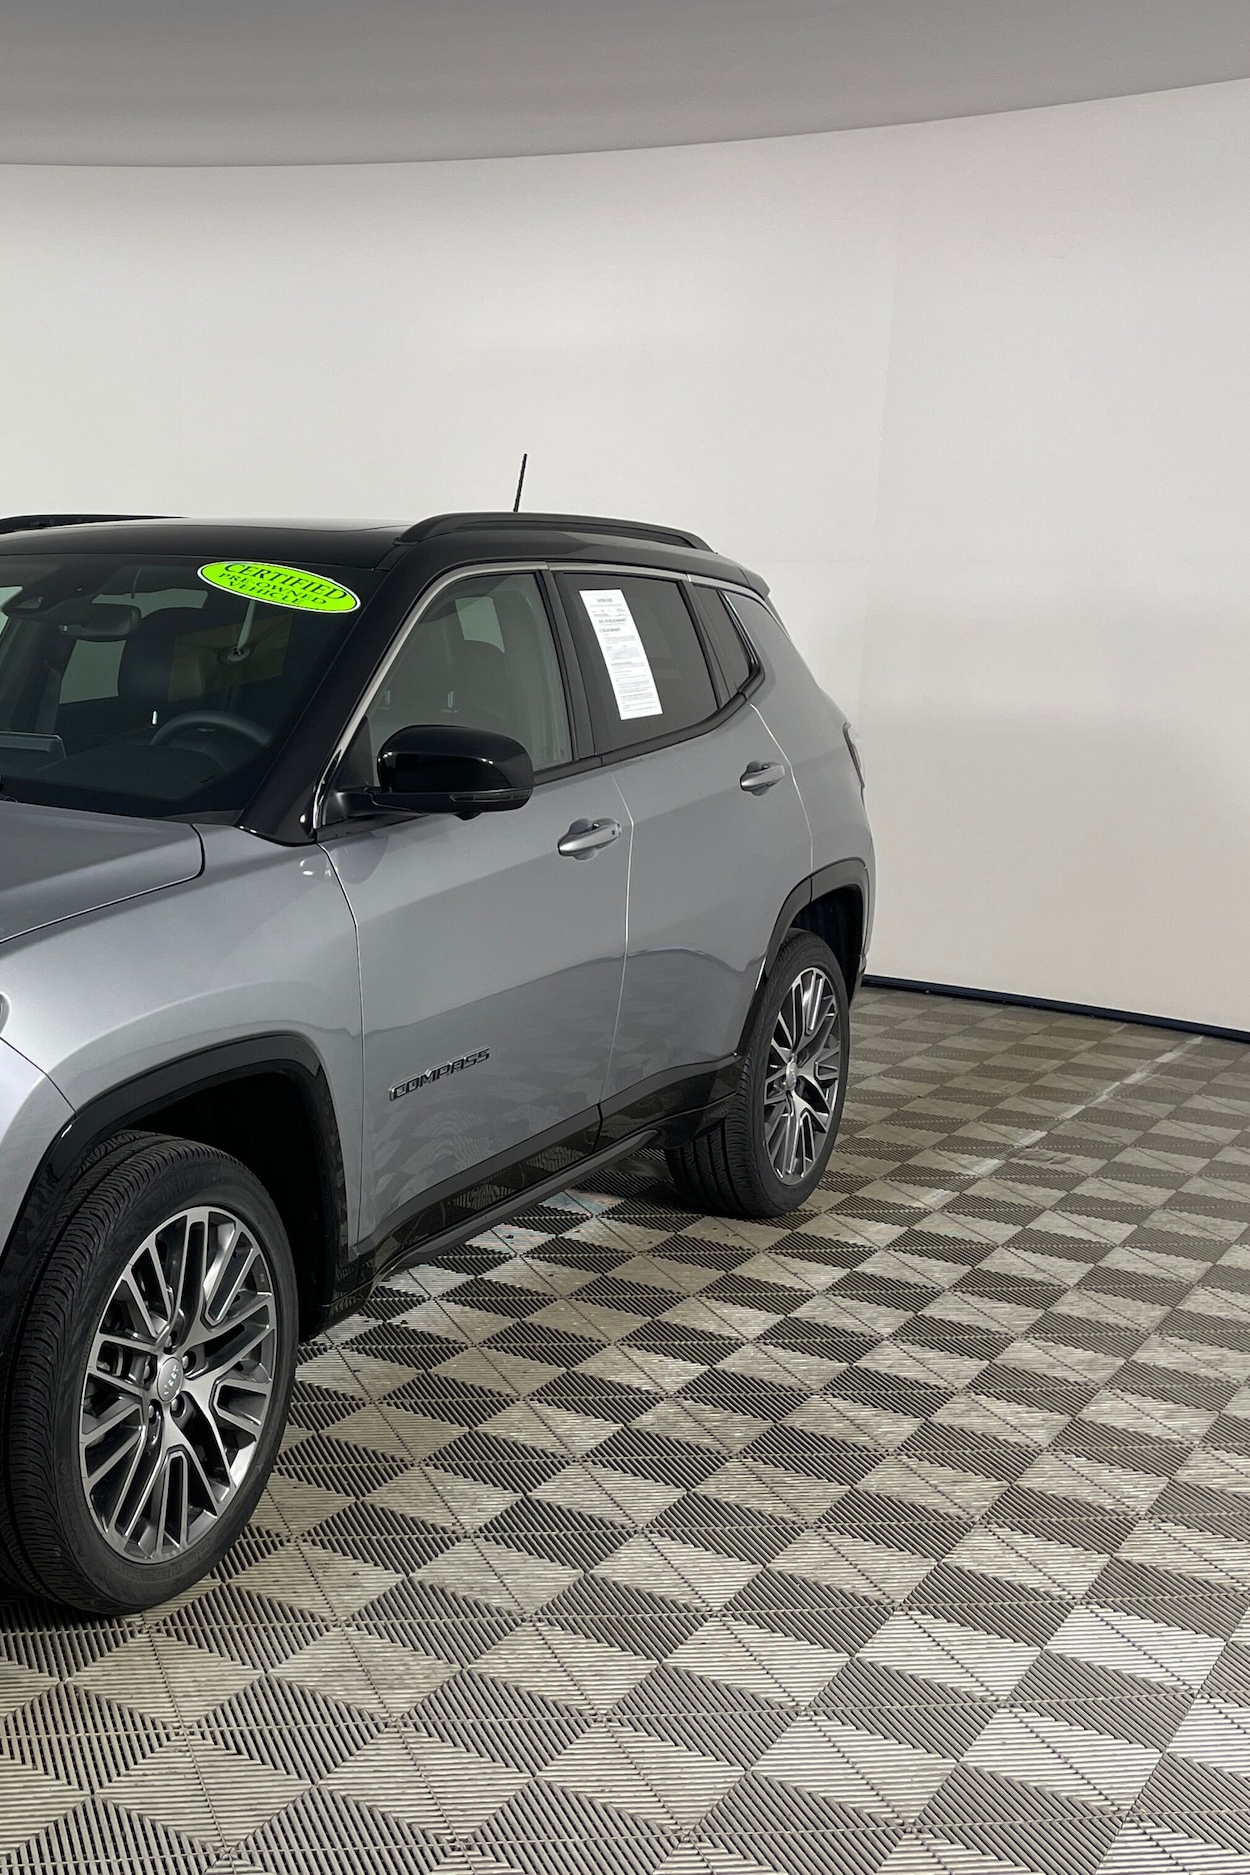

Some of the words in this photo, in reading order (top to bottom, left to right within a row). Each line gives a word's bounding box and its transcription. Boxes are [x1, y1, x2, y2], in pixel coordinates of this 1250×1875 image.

[224, 562, 348, 600] CERTIFIED
[227, 580, 303, 605] VEHICLE
[388, 1045, 491, 1102] COMPASS
